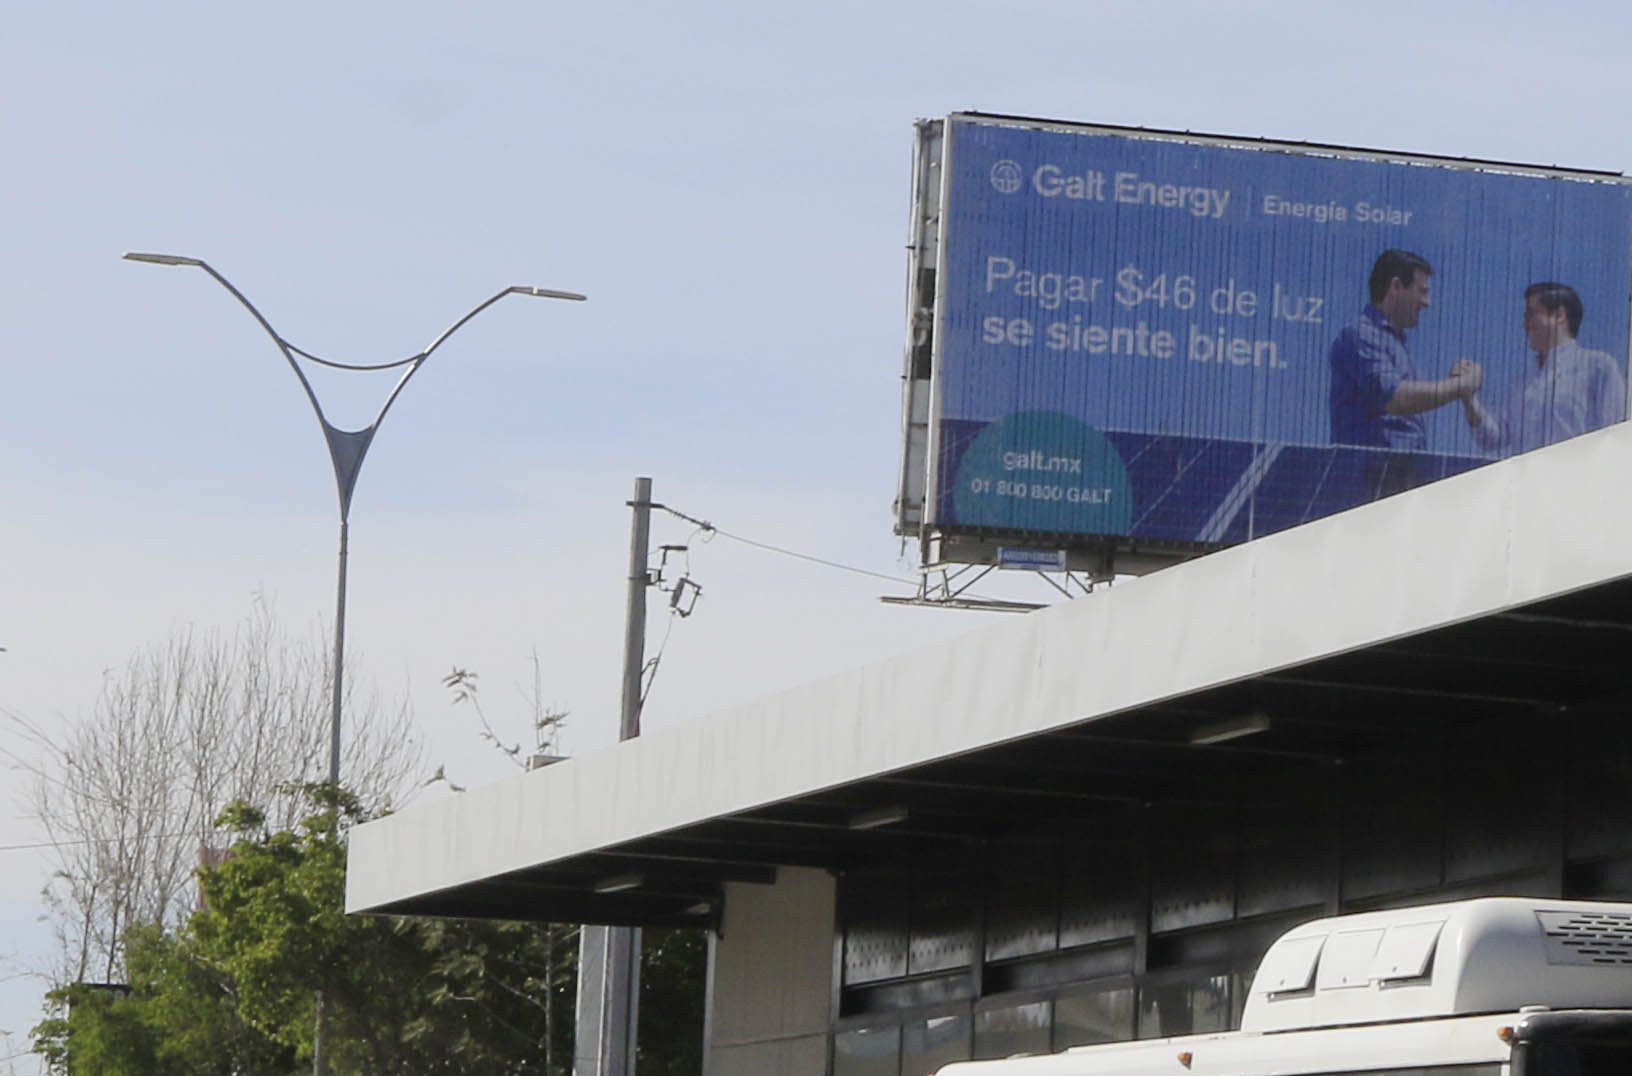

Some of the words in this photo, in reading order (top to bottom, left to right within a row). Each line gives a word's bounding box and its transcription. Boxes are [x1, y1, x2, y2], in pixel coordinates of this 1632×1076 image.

[1032, 165, 1105, 200] Galt
[1114, 173, 1231, 217] Energy
[1263, 195, 1346, 222] Energía
[1355, 203, 1413, 226] Solar
[985, 256, 1105, 310] Pagar
[1114, 264, 1196, 311] $46
[1210, 278, 1259, 317] de
[1271, 282, 1324, 324] luz
[982, 315, 1034, 348] se
[1045, 315, 1177, 360] siente
[1188, 324, 1288, 369] bien.
[1003, 450, 1082, 472] galt.mx
[971, 478, 992, 494] 01
[996, 480, 1027, 498] 800
[1066, 487, 1112, 504] GALT
